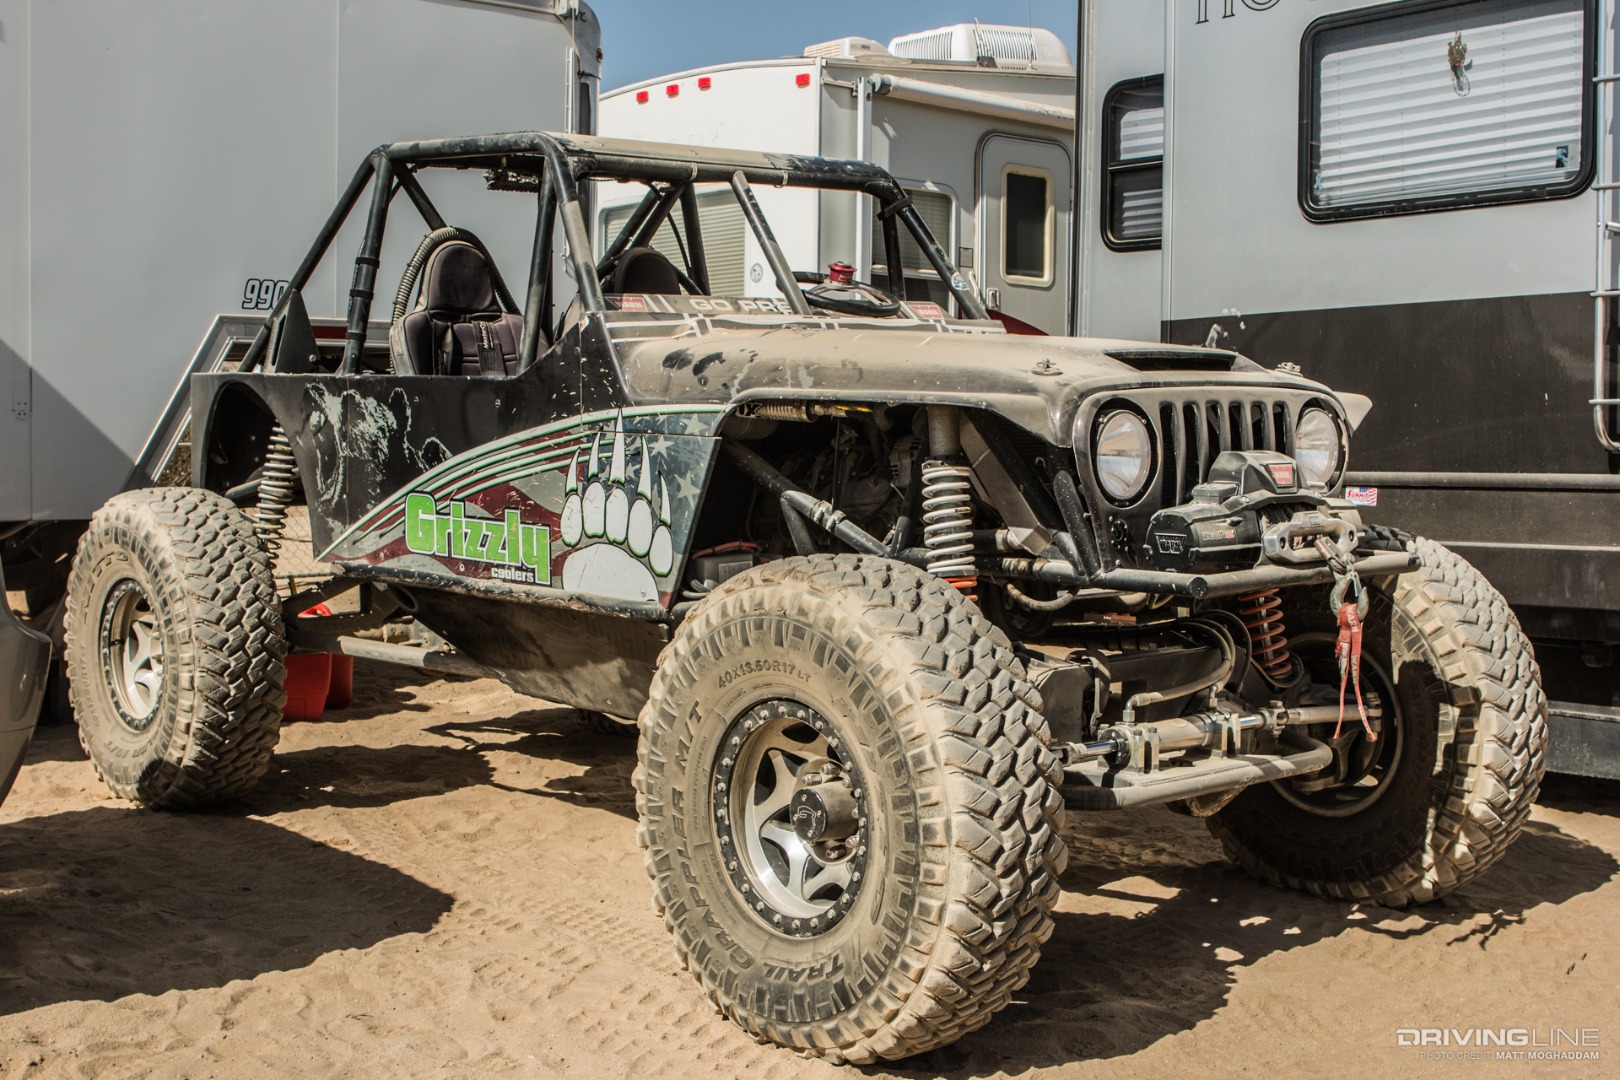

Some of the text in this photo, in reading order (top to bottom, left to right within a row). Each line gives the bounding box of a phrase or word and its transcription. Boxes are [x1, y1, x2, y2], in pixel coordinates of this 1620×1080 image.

[689, 299, 734, 311] GO
[404, 492, 551, 585] Grizzly
[1159, 539, 1182, 554] WARN
[718, 659, 812, 689] 40X13.50R17 LT
[672, 699, 844, 983] TRAIL GRAPPLER M/T
